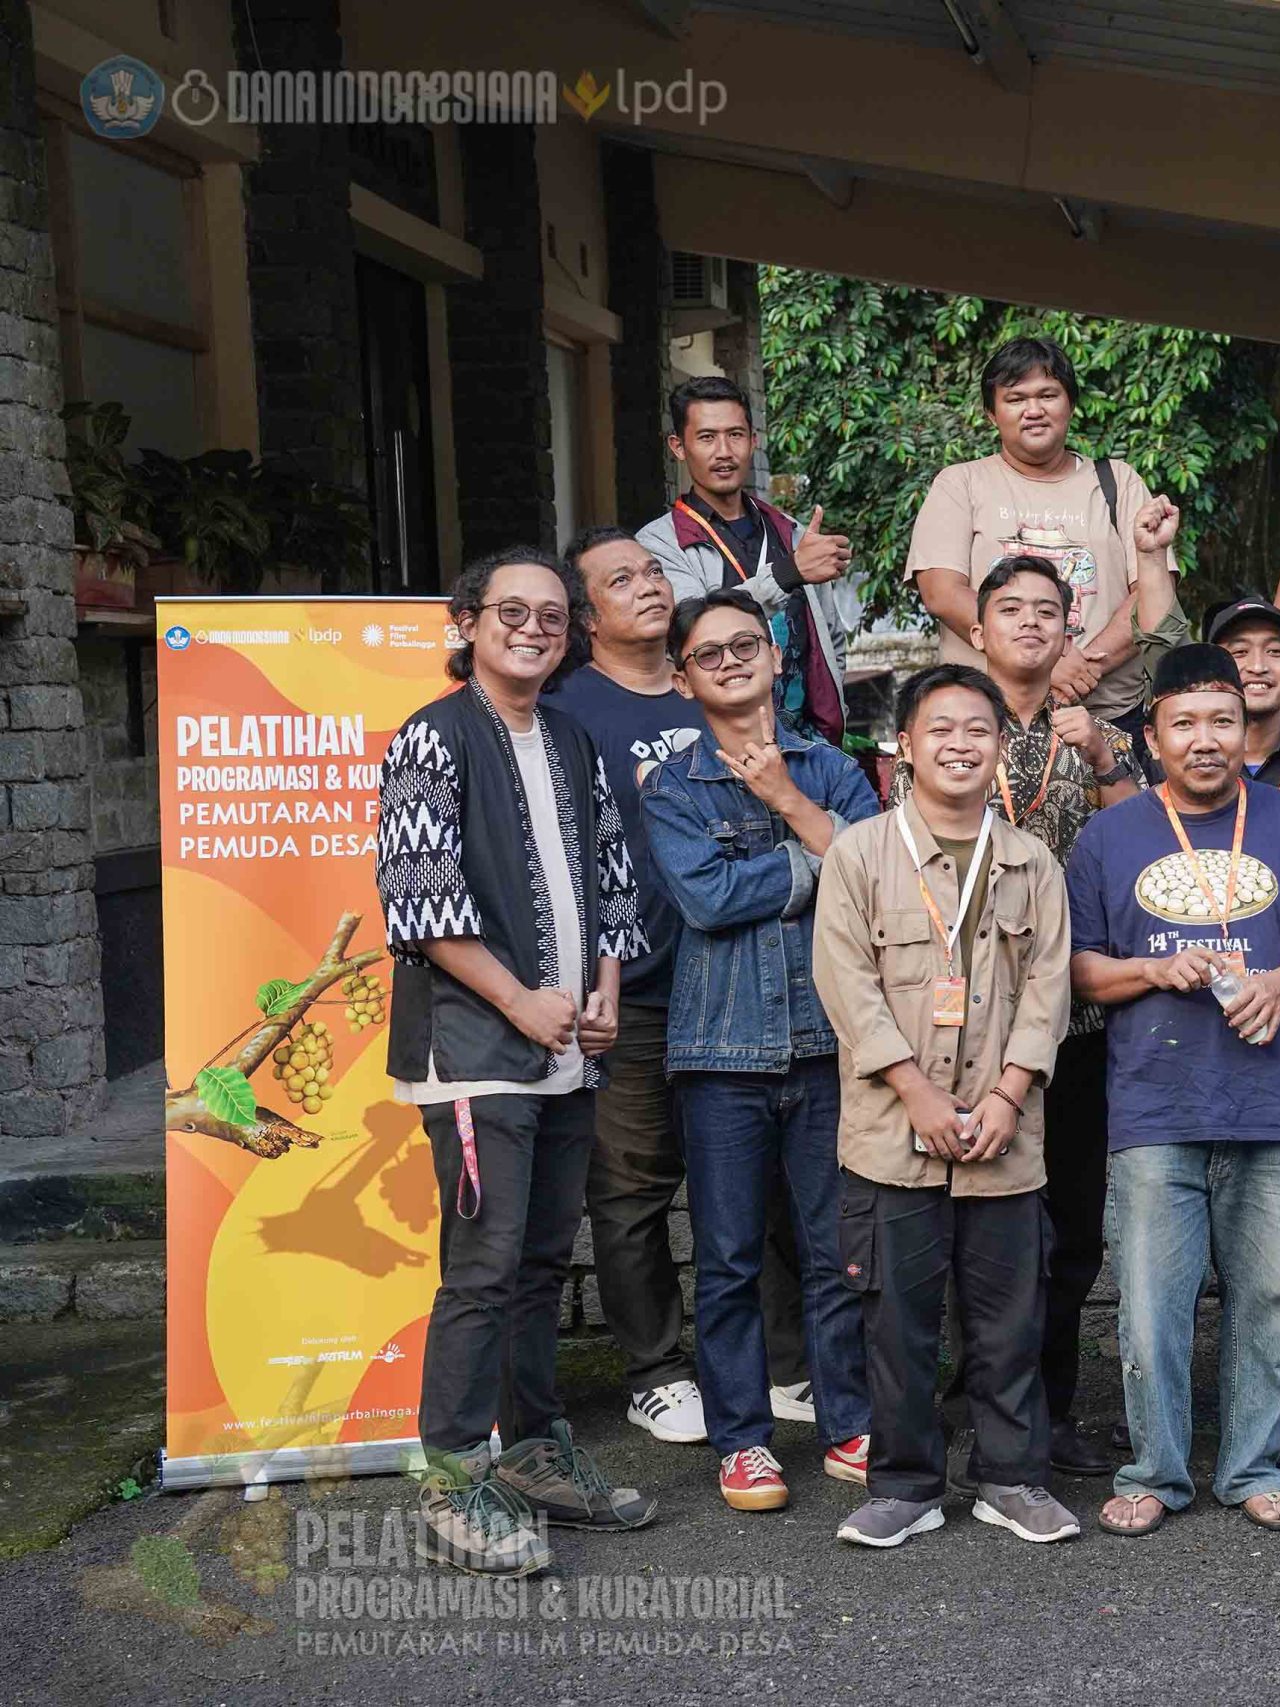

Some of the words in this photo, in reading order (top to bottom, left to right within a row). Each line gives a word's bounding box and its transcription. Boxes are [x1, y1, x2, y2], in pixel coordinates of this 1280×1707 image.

[309, 628, 342, 644] lpdp
[176, 713, 365, 757] PELATIHAN
[177, 764, 318, 792] PROGRAMASI
[325, 766, 342, 791] &
[180, 801, 352, 825] PEMUTARAN
[180, 835, 300, 859] PEMUDA
[311, 834, 378, 857] DESA
[1176, 938, 1252, 954] FESTIVAL
[223, 1405, 420, 1430] www.festivalfilmpurbalingga.i
